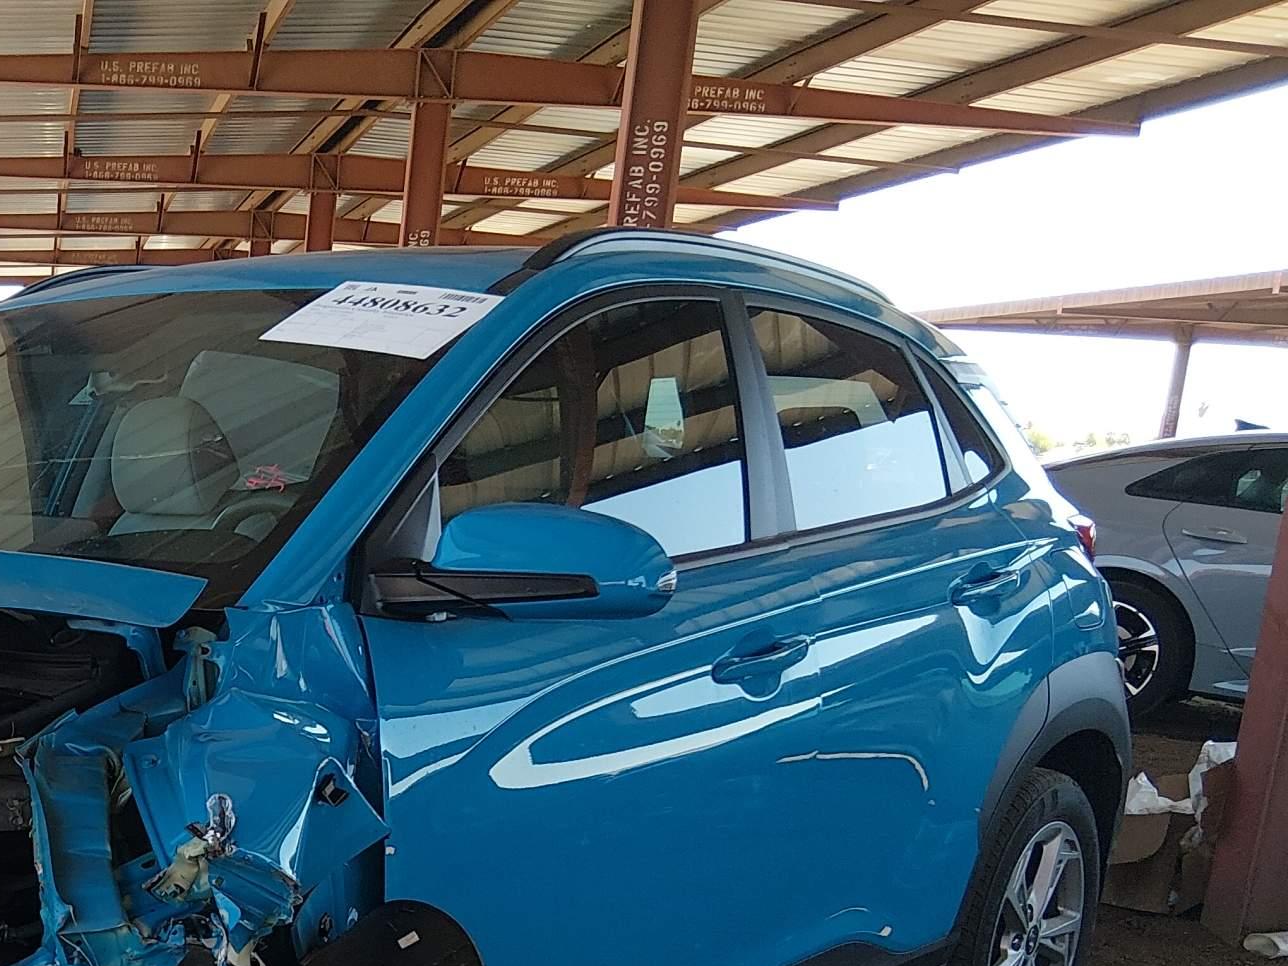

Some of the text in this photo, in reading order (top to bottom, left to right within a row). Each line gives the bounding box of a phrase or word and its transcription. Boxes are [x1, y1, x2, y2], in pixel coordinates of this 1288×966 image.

[101, 60, 123, 73] U.S.
[129, 61, 174, 74] PREFAB
[694, 86, 765, 100] PREFAB INC
[633, 119, 651, 155] INC.
[505, 177, 539, 187] PREFAB
[332, 293, 468, 318] 44808632
